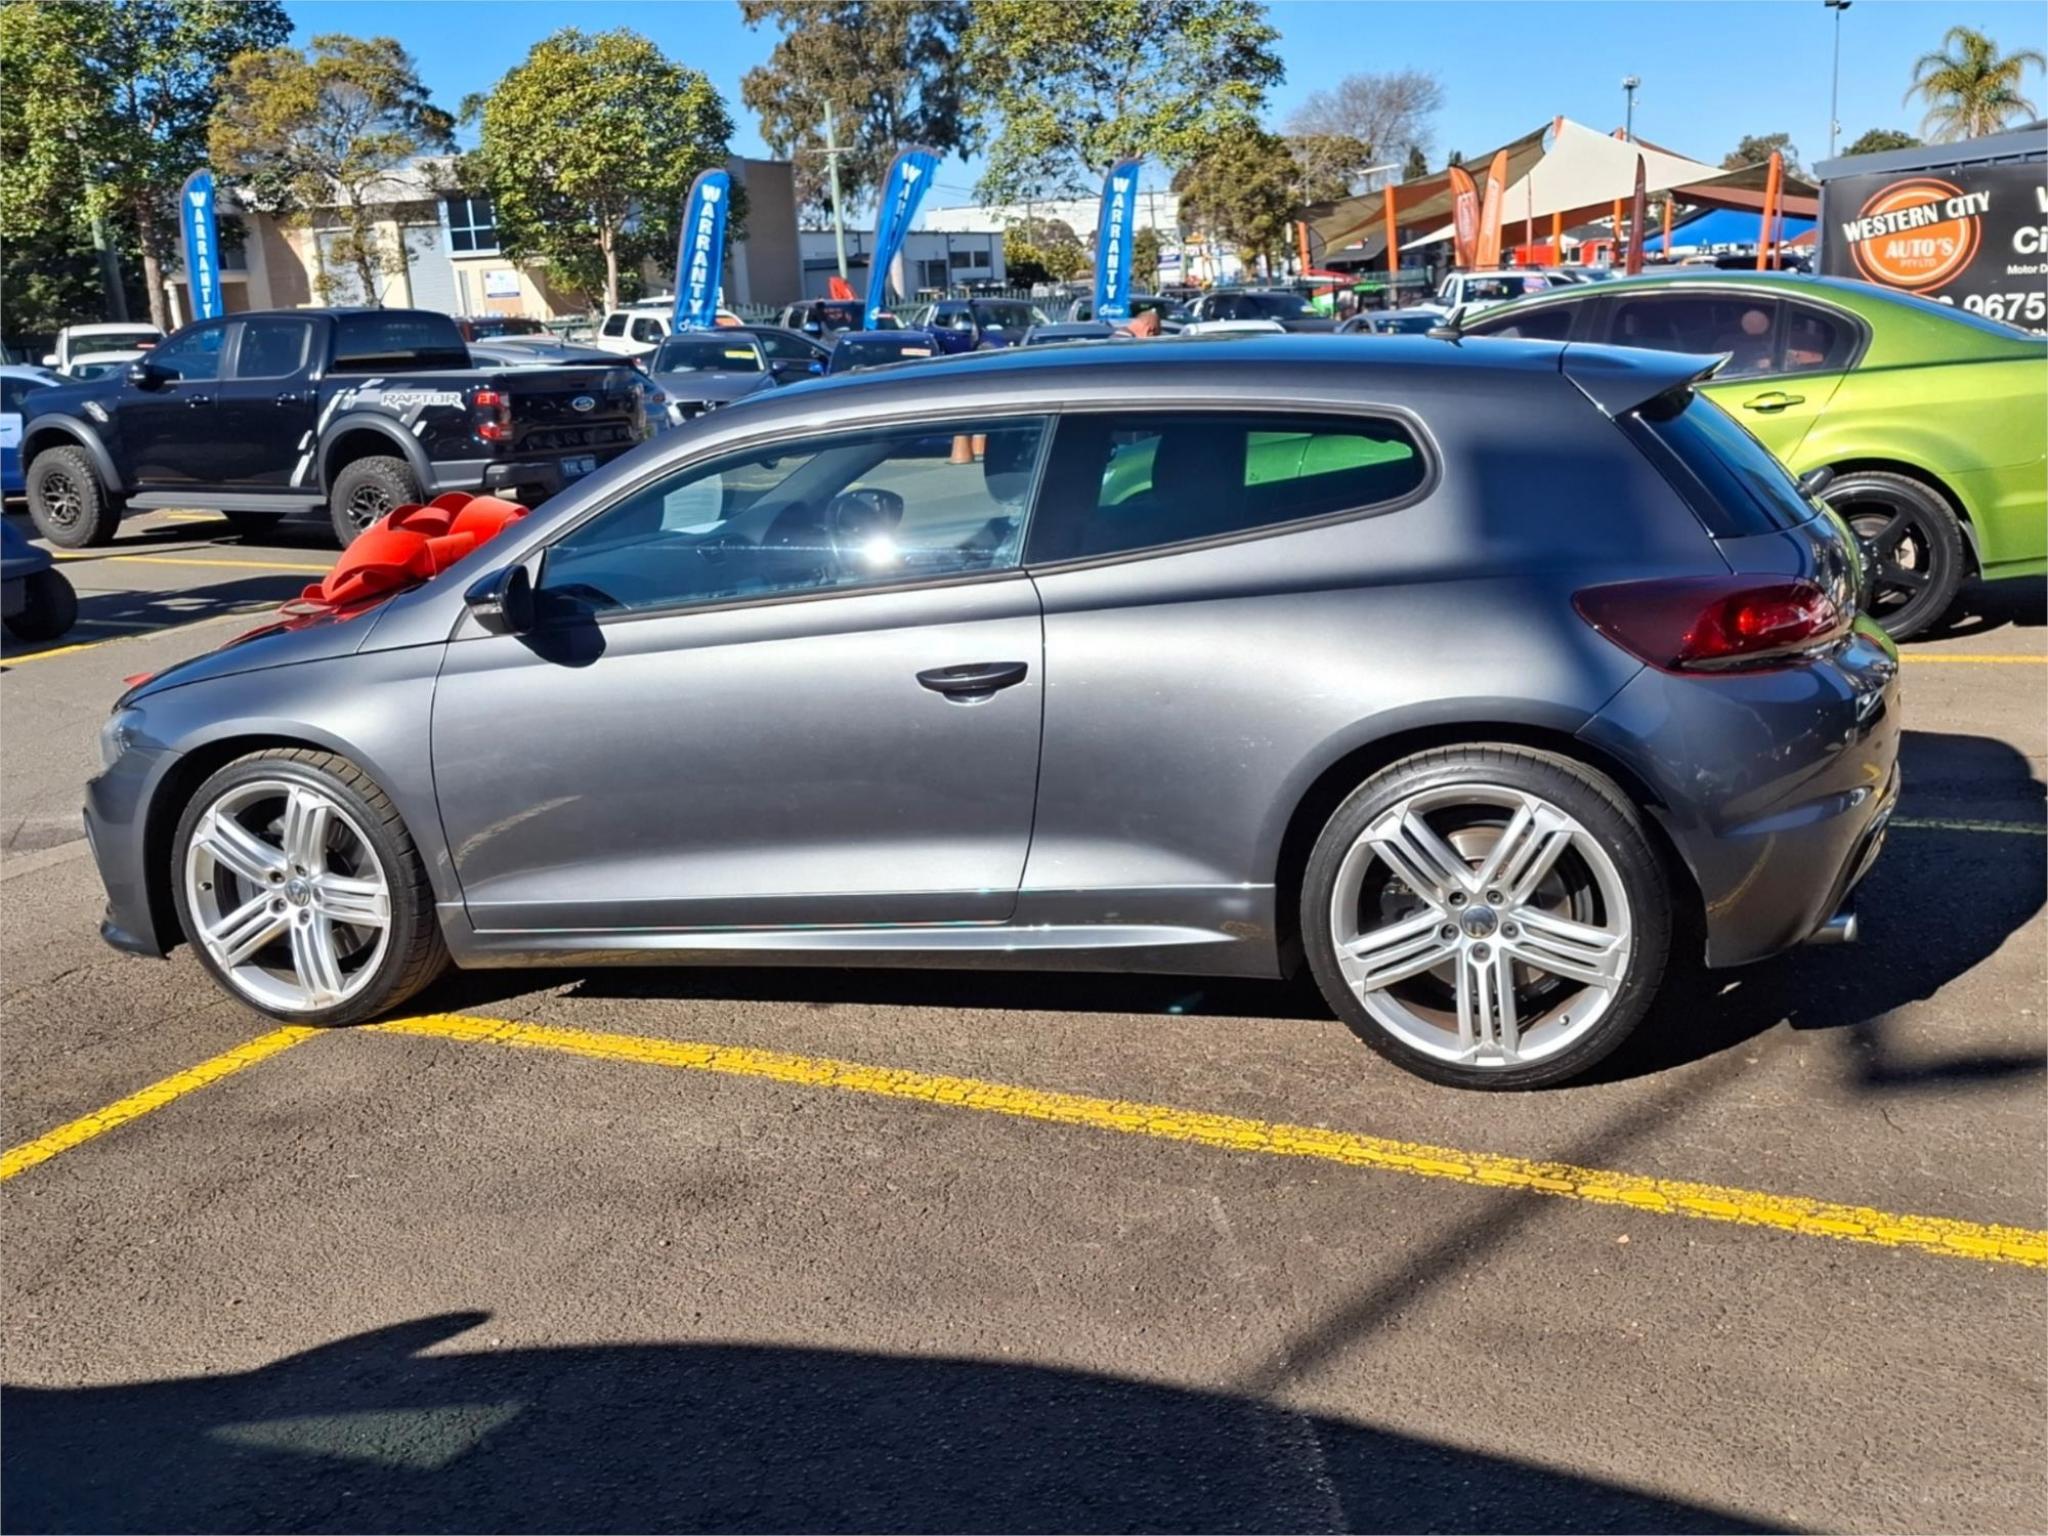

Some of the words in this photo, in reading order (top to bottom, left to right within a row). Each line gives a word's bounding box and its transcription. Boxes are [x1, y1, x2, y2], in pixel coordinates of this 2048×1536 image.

[1106, 176, 1130, 299] WARRANTY
[1842, 203, 1939, 243] WESTERN
[1946, 190, 1991, 219] CITY
[188, 191, 212, 319] WARRANTY
[689, 184, 721, 315] WARRANTY
[1885, 237, 1954, 259] AUTO'S
[2006, 264, 2038, 275] Motor
[381, 392, 466, 411] RAPTOR
